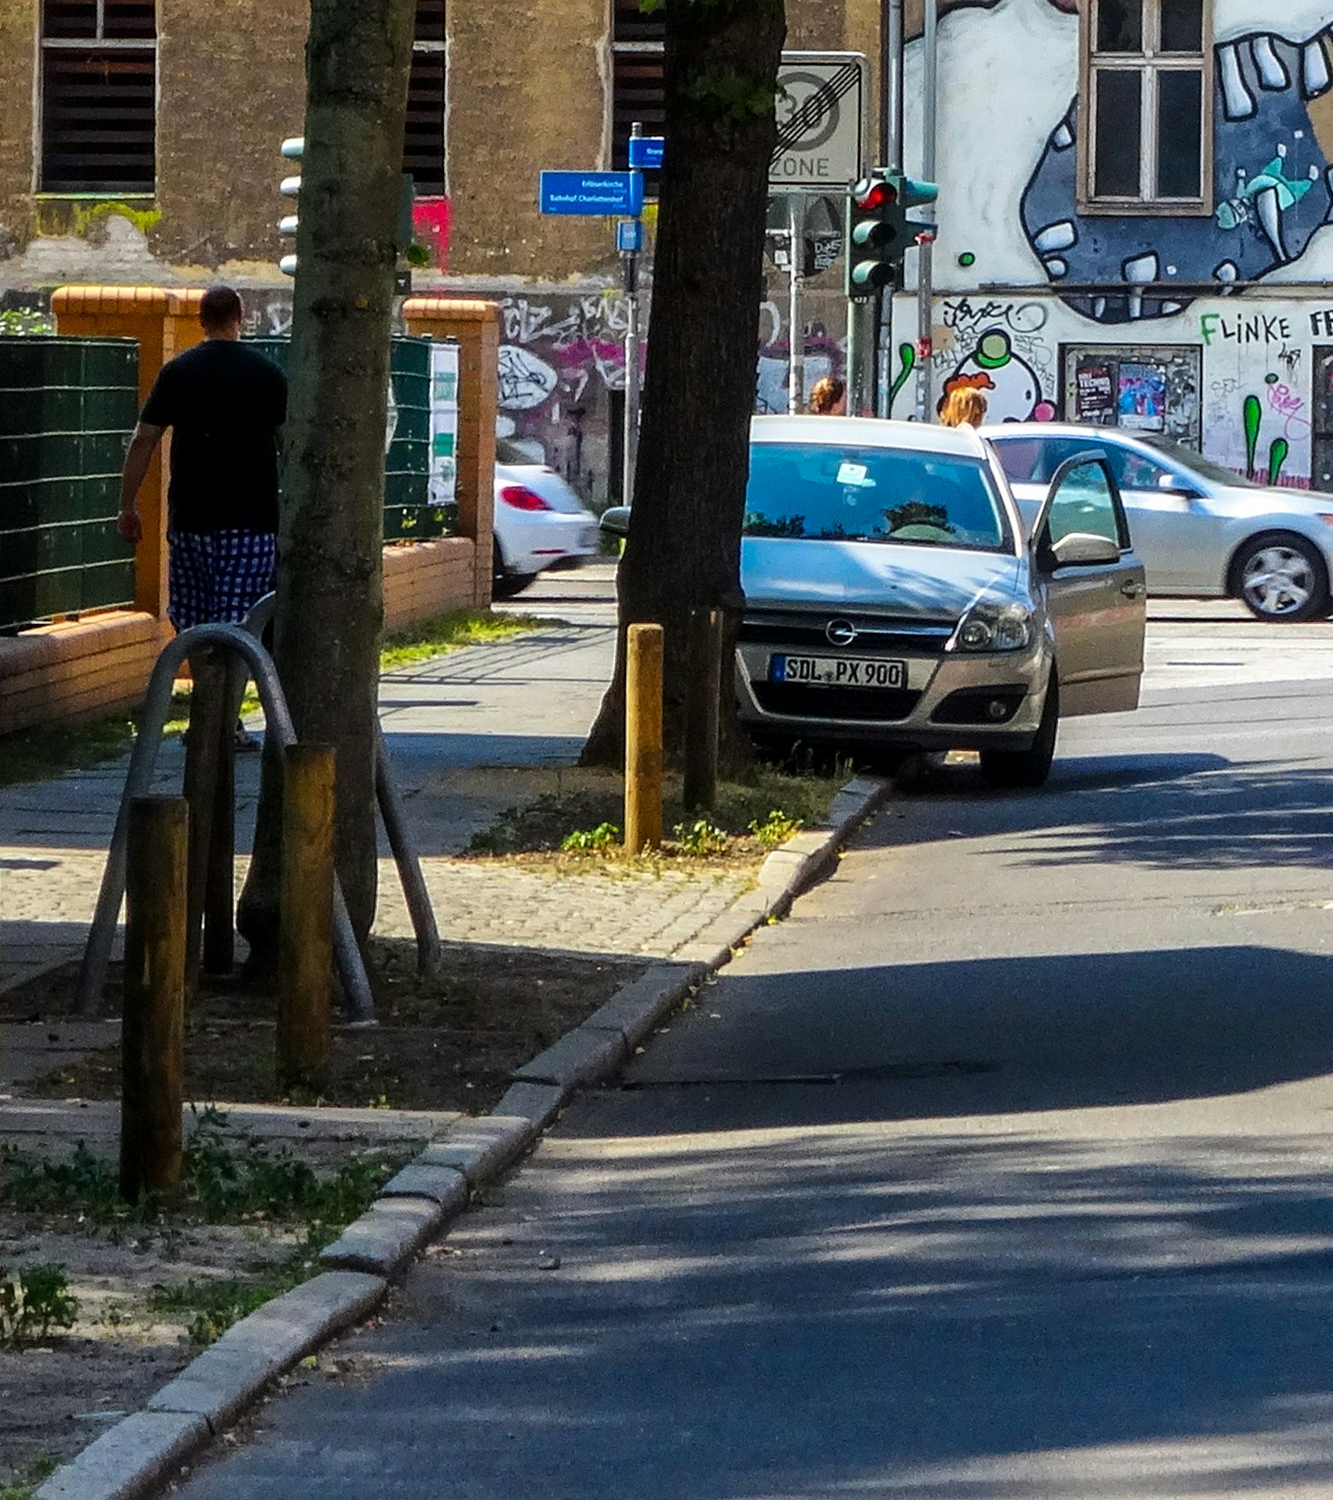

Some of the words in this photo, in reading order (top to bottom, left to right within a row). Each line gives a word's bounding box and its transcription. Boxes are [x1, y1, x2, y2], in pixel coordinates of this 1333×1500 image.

[769, 158, 829, 177] ZONE
[786, 658, 822, 681] SDL
[836, 661, 860, 683] PX
[865, 664, 900, 685] 900
